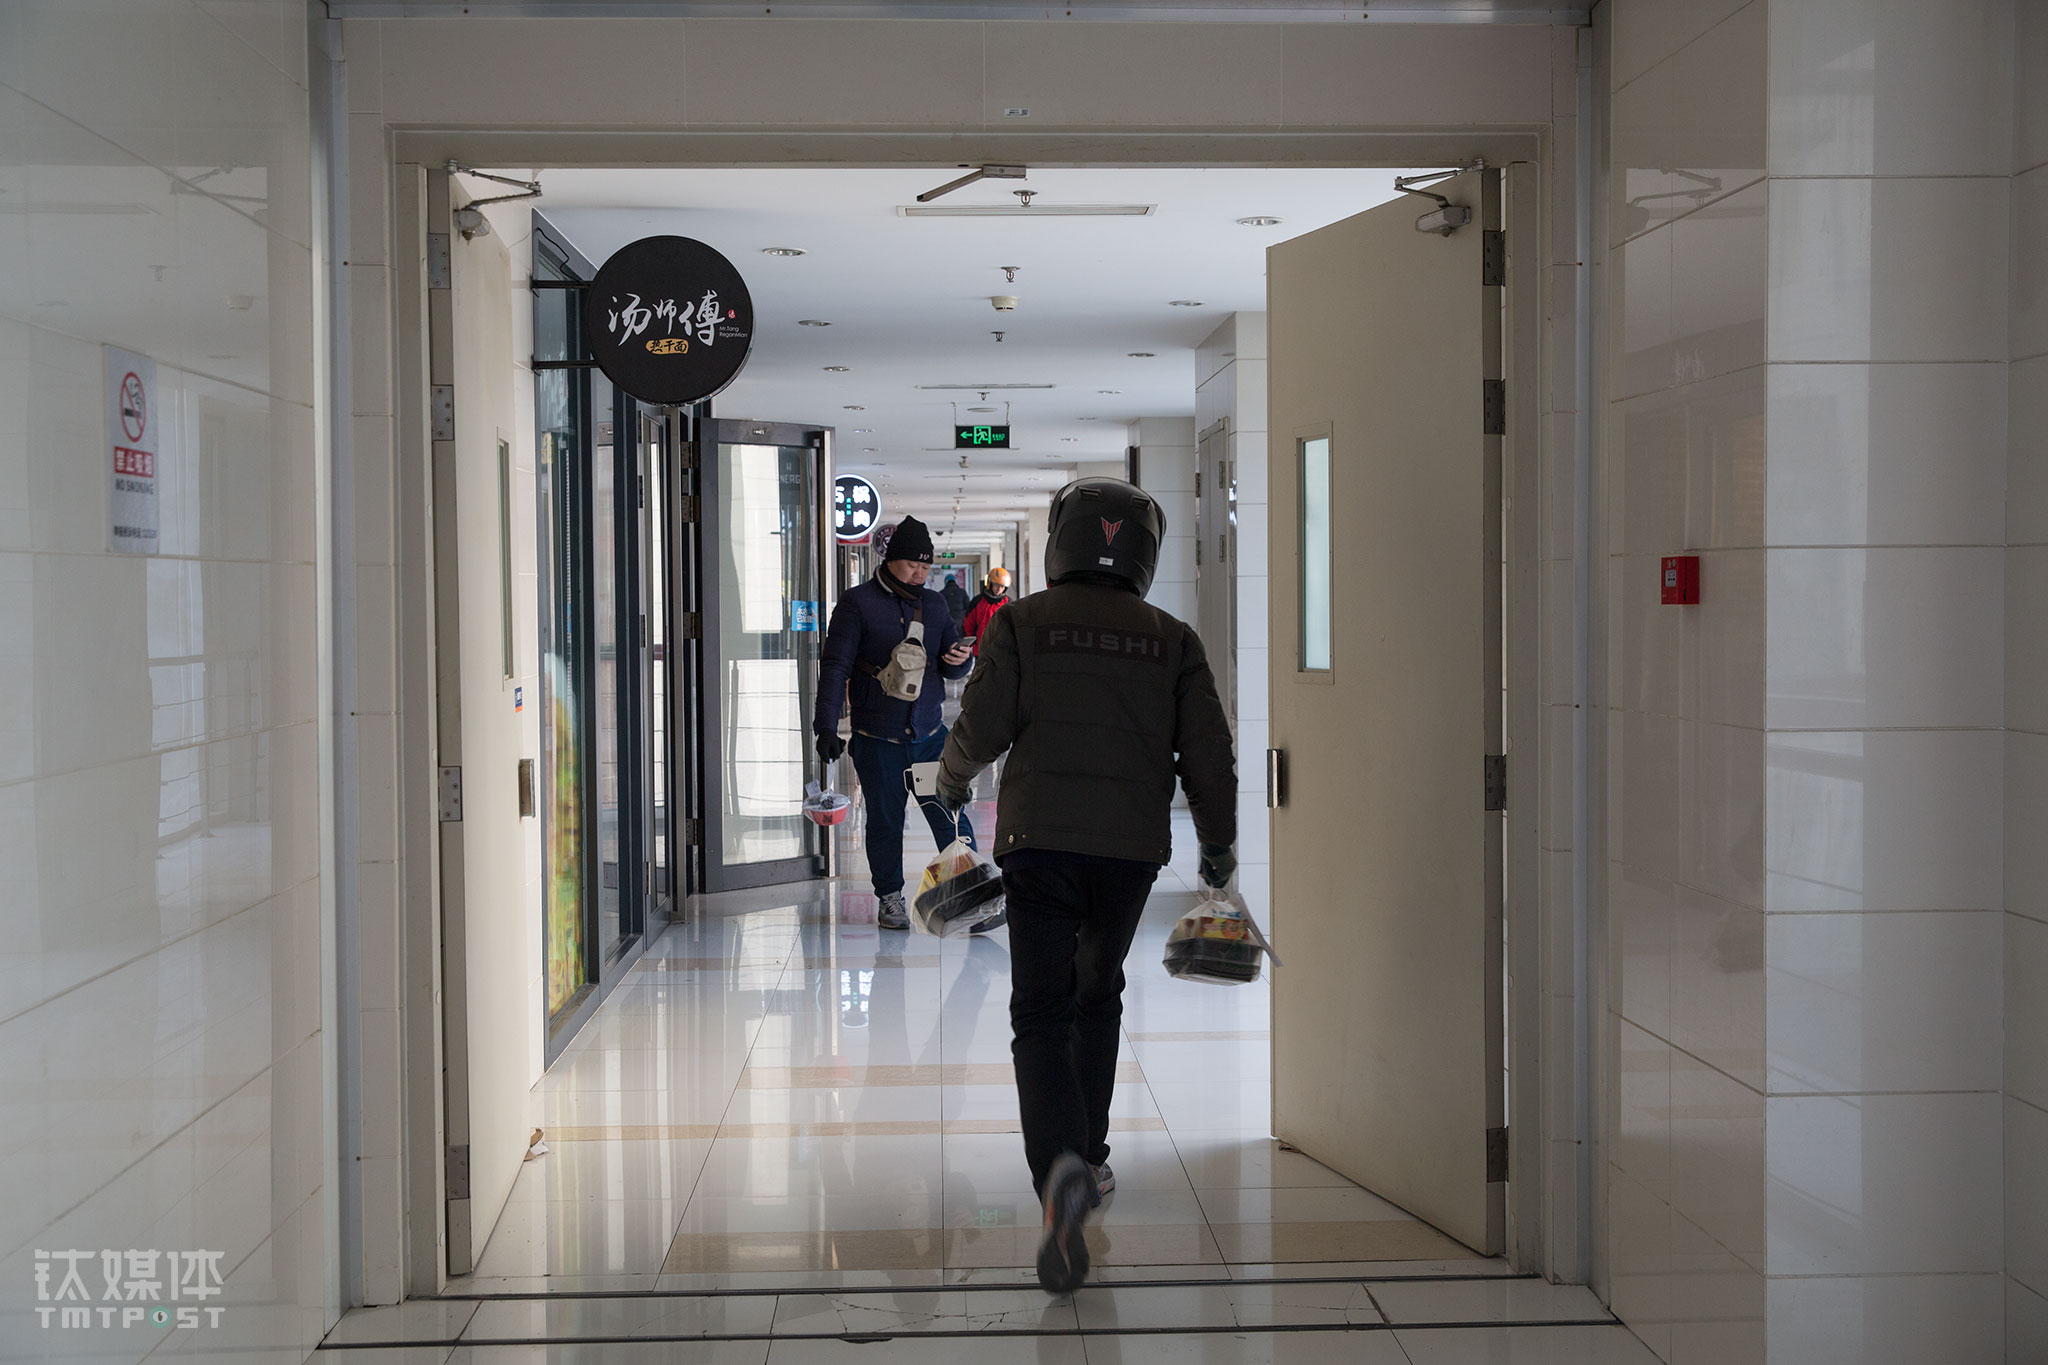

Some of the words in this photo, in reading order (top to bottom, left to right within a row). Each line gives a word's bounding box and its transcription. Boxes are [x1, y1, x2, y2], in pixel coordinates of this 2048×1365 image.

[608, 289, 726, 347] 汤师傅
[650, 340, 687, 353] 热干面
[1049, 630, 1160, 657] FUSHI
